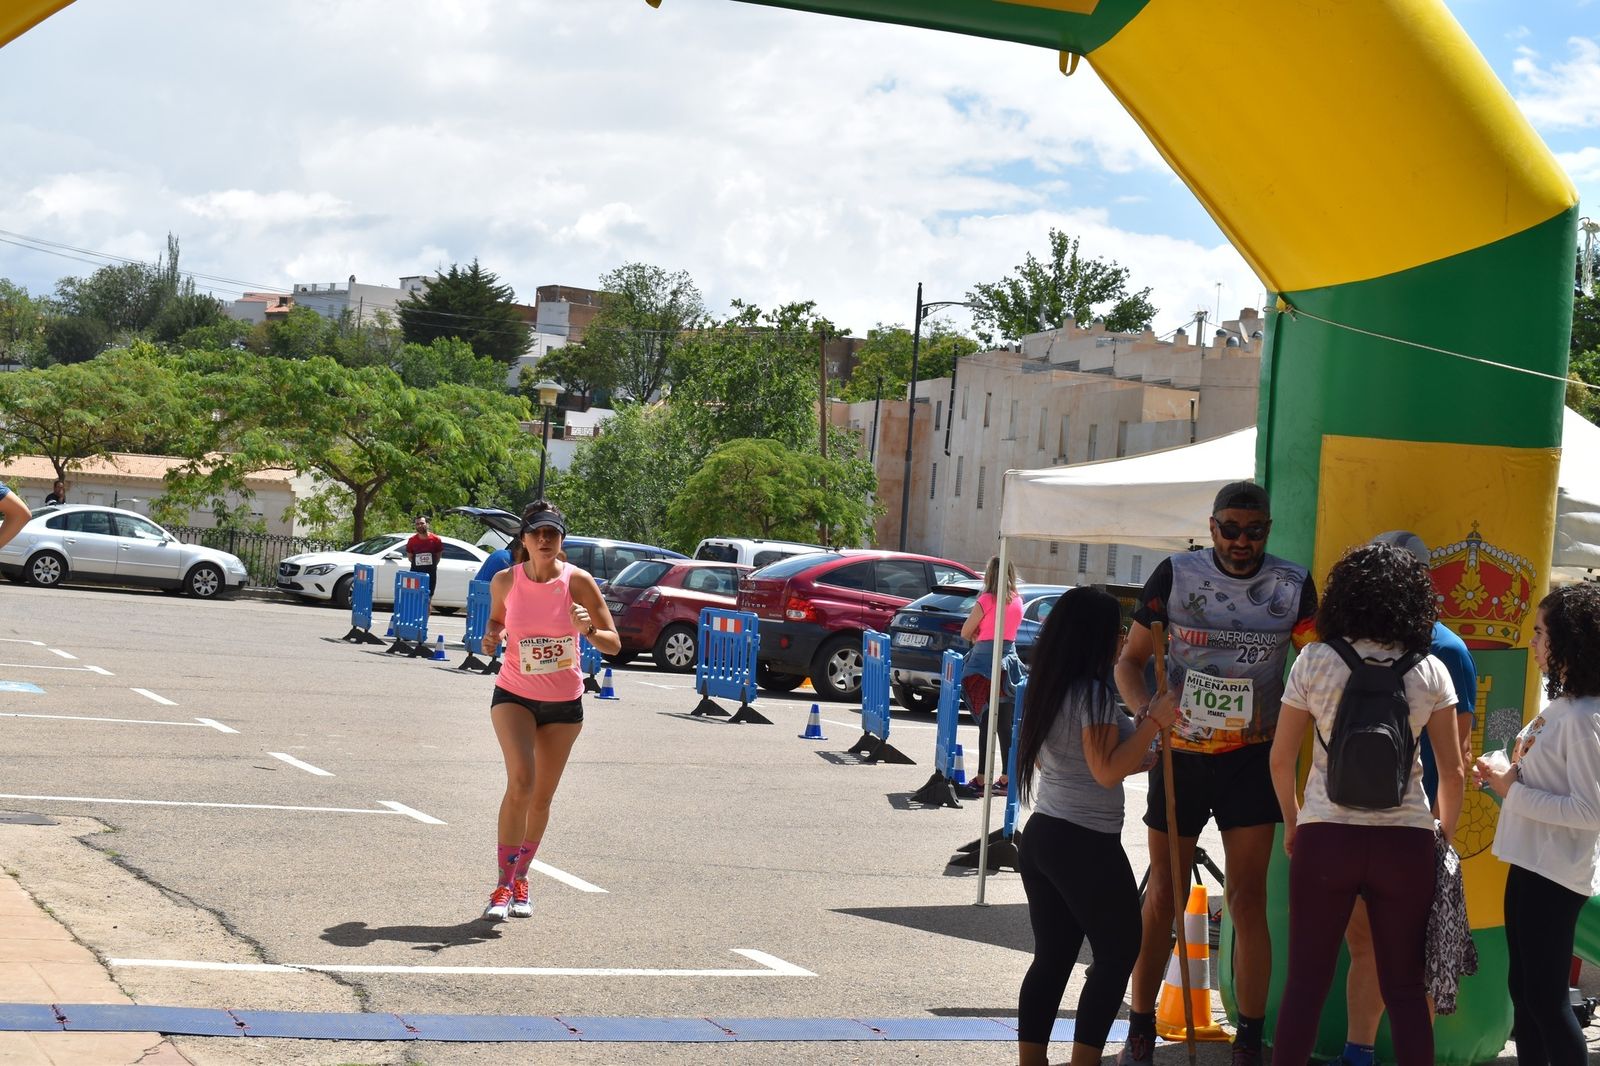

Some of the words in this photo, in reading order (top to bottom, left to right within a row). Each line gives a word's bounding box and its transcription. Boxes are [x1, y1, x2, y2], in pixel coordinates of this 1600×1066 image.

[1218, 631, 1277, 646] AFRICANA
[532, 644, 564, 660] 553
[1187, 676, 1250, 692] MILENARIA
[1193, 689, 1244, 712] 1021
